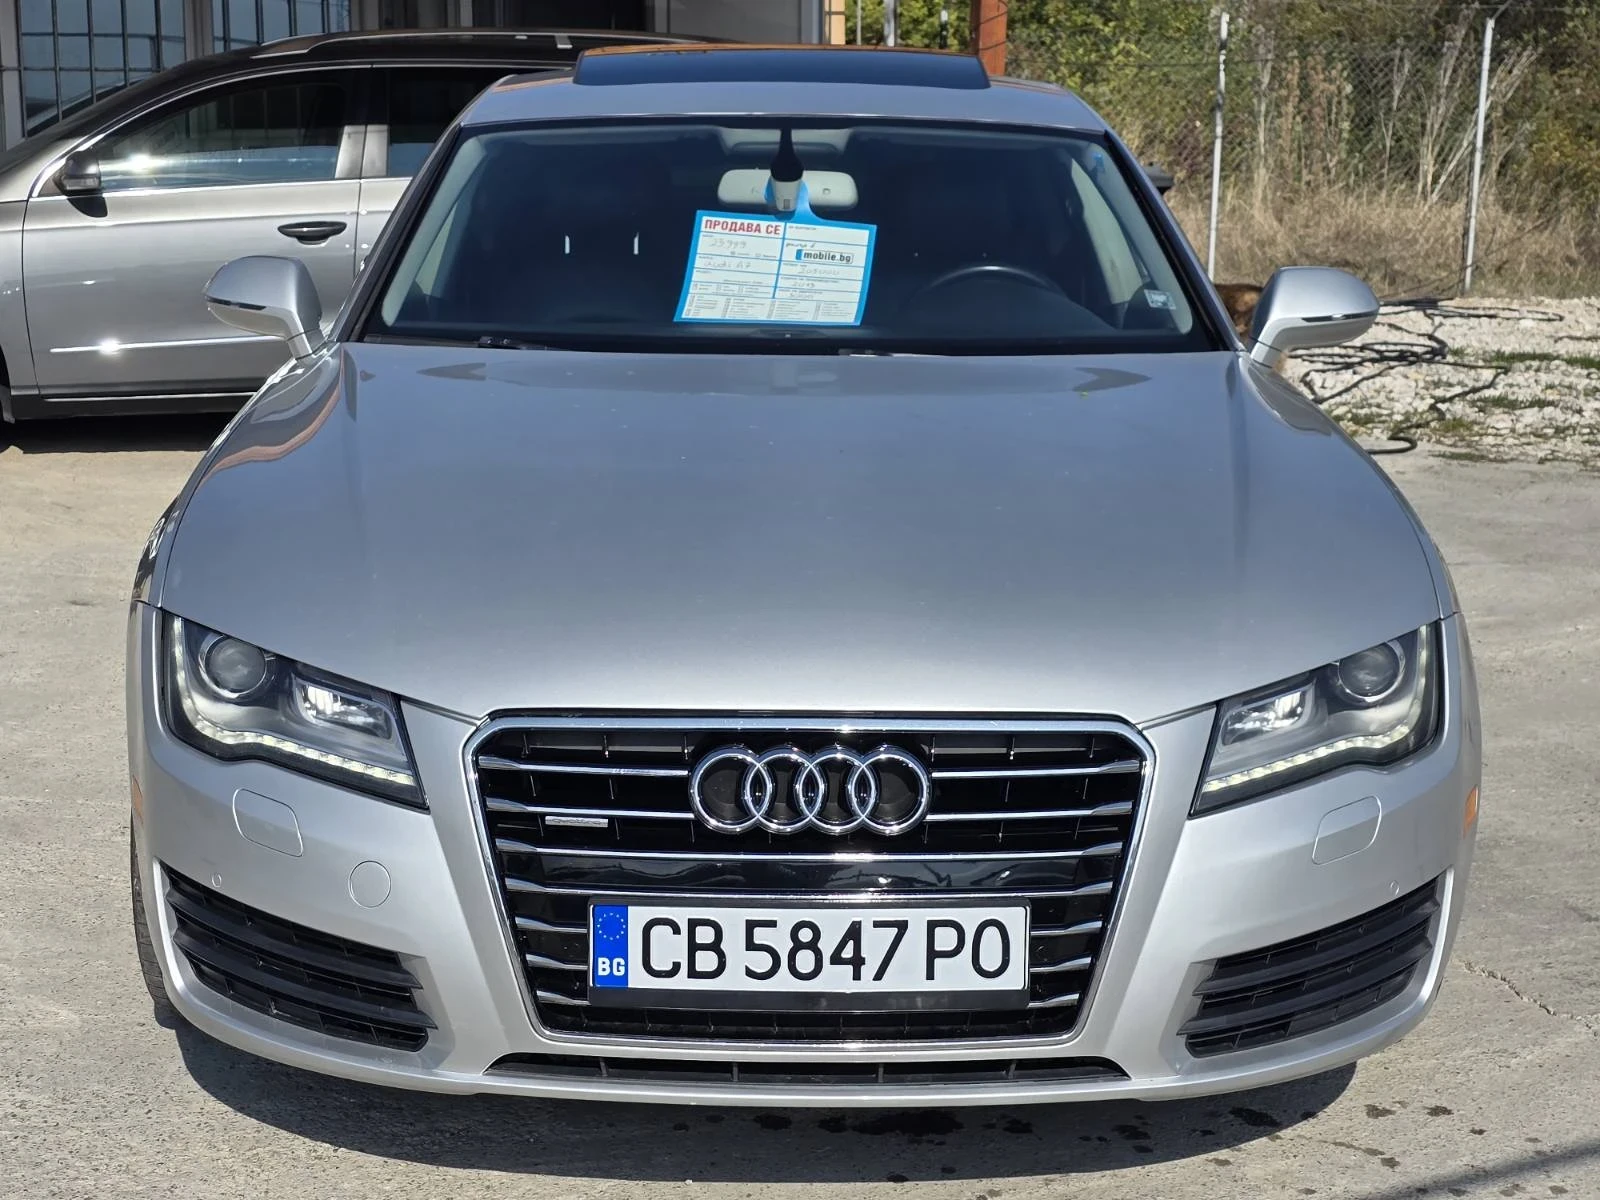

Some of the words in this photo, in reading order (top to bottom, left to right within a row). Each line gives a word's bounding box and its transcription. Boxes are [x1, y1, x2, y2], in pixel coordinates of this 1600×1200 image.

[704, 219, 762, 233] ПРОДАВА
[765, 224, 782, 235] СЕ
[803, 251, 852, 263] mobile.bg
[641, 917, 728, 980] CB
[744, 918, 909, 982] 5847
[596, 957, 626, 977] BG
